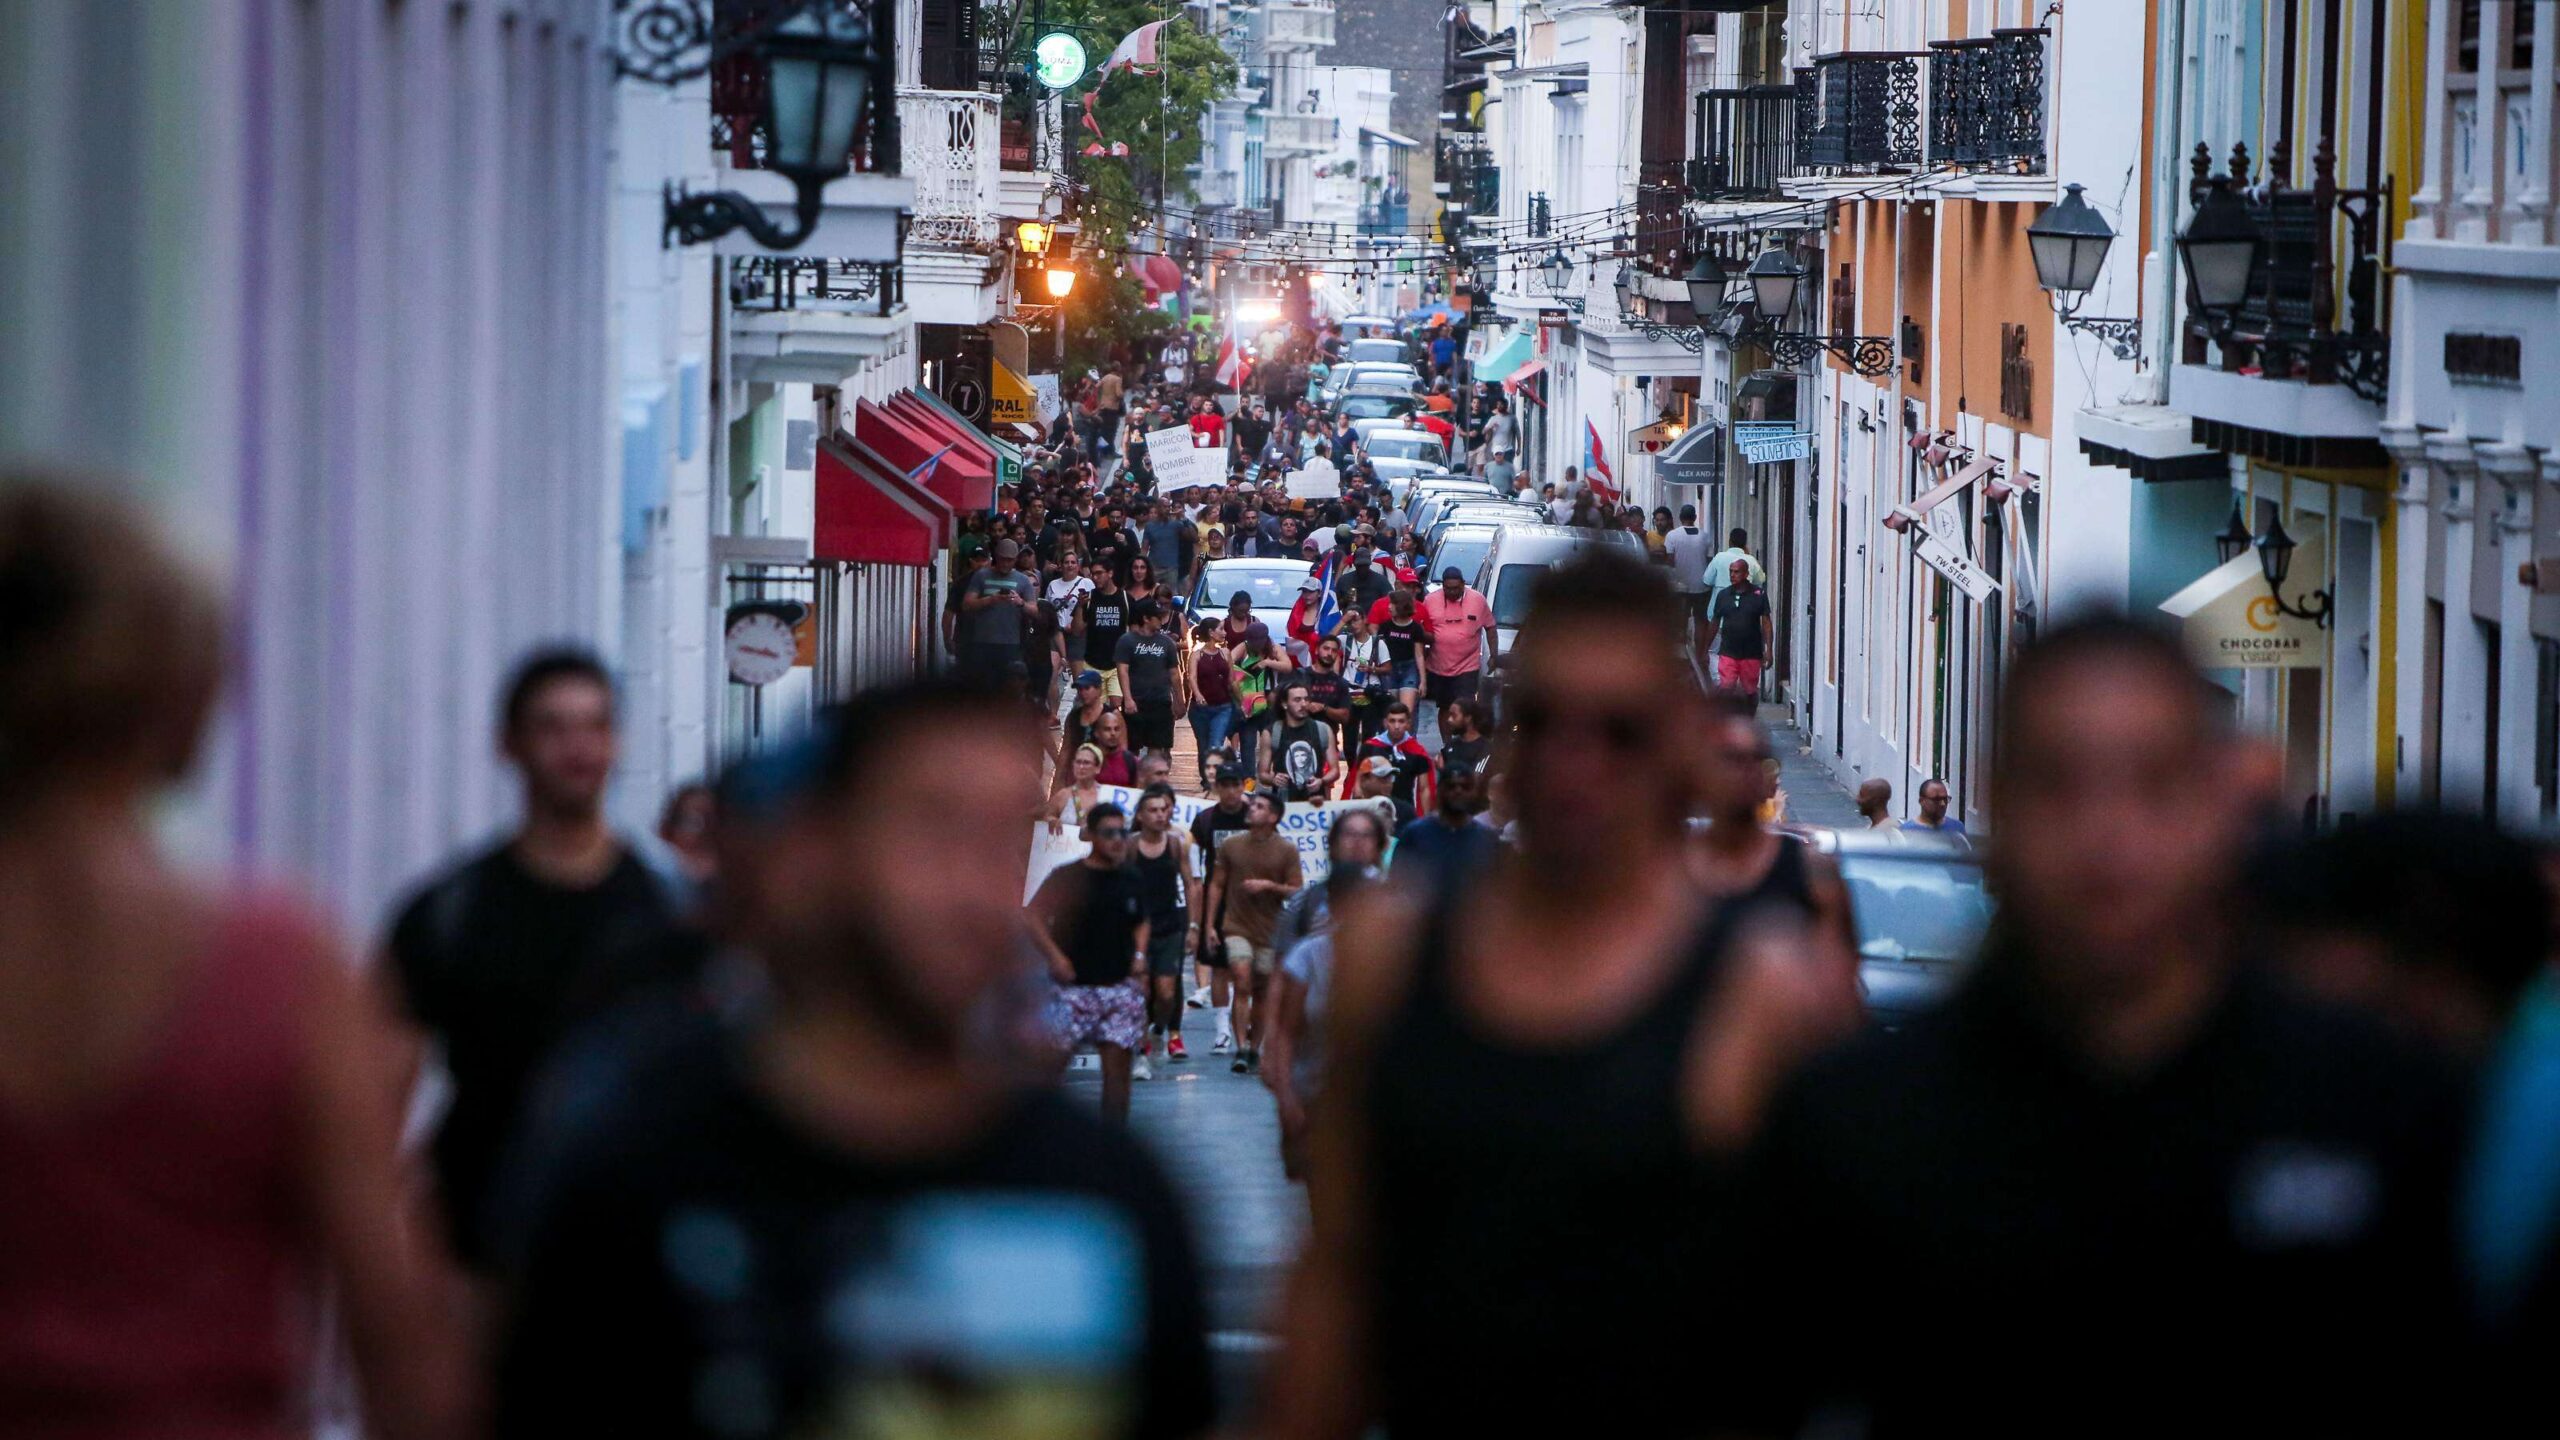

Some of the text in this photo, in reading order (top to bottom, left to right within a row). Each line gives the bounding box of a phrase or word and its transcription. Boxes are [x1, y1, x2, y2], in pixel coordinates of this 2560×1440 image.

[960, 386, 971, 411] 7
[991, 399, 1025, 413] RAL
[1154, 455, 1196, 473] HOMBRE
[1935, 554, 1972, 587] TW STEEL
[1134, 642, 1164, 656] Hurley
[2220, 638, 2300, 649] CHOCOBAR
